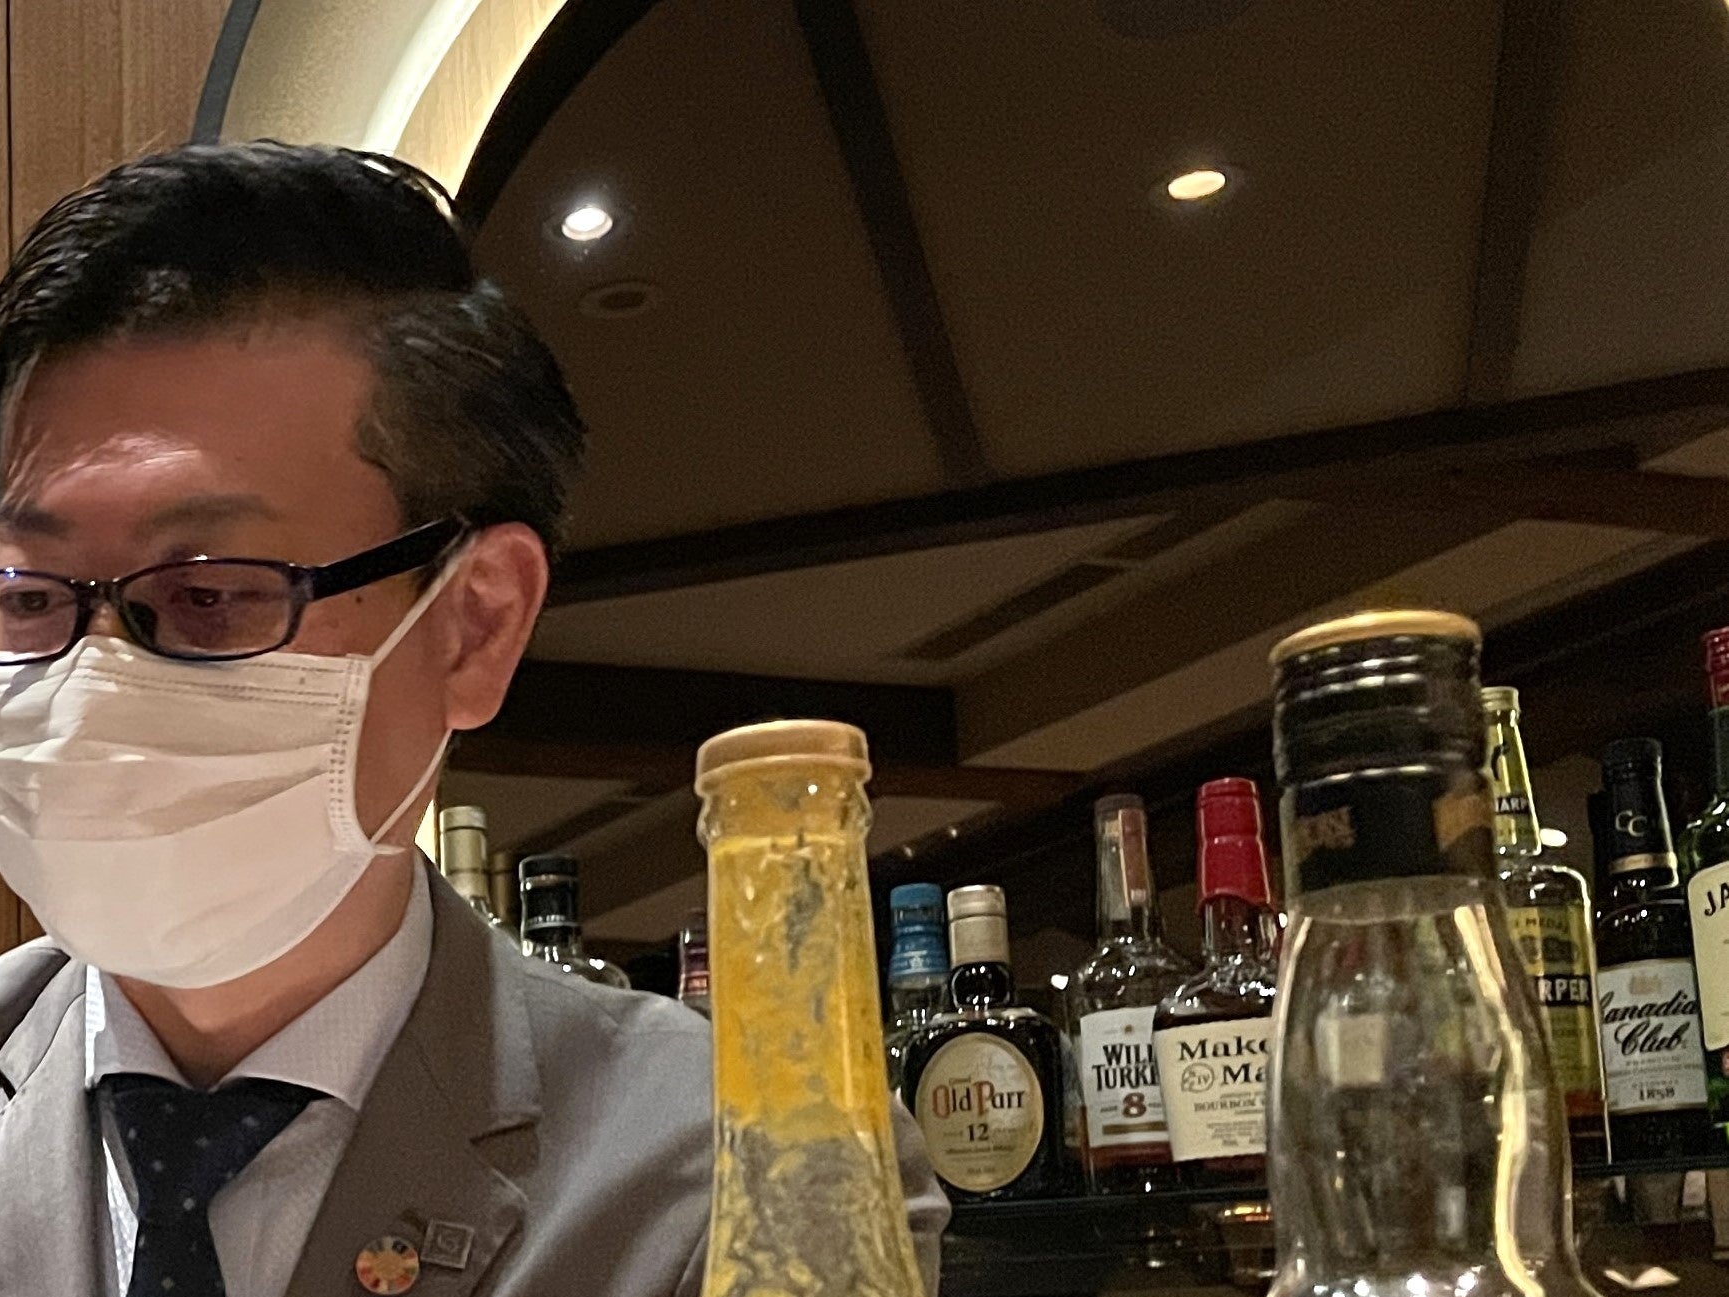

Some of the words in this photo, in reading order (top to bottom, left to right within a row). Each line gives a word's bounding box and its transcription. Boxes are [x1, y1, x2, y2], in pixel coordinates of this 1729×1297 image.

[1614, 1018, 1691, 1056] Club
[932, 1084, 971, 1119] Old
[973, 1080, 1025, 1117] Parr
[1122, 1092, 1147, 1118] 8
[968, 1123, 989, 1142] 12
